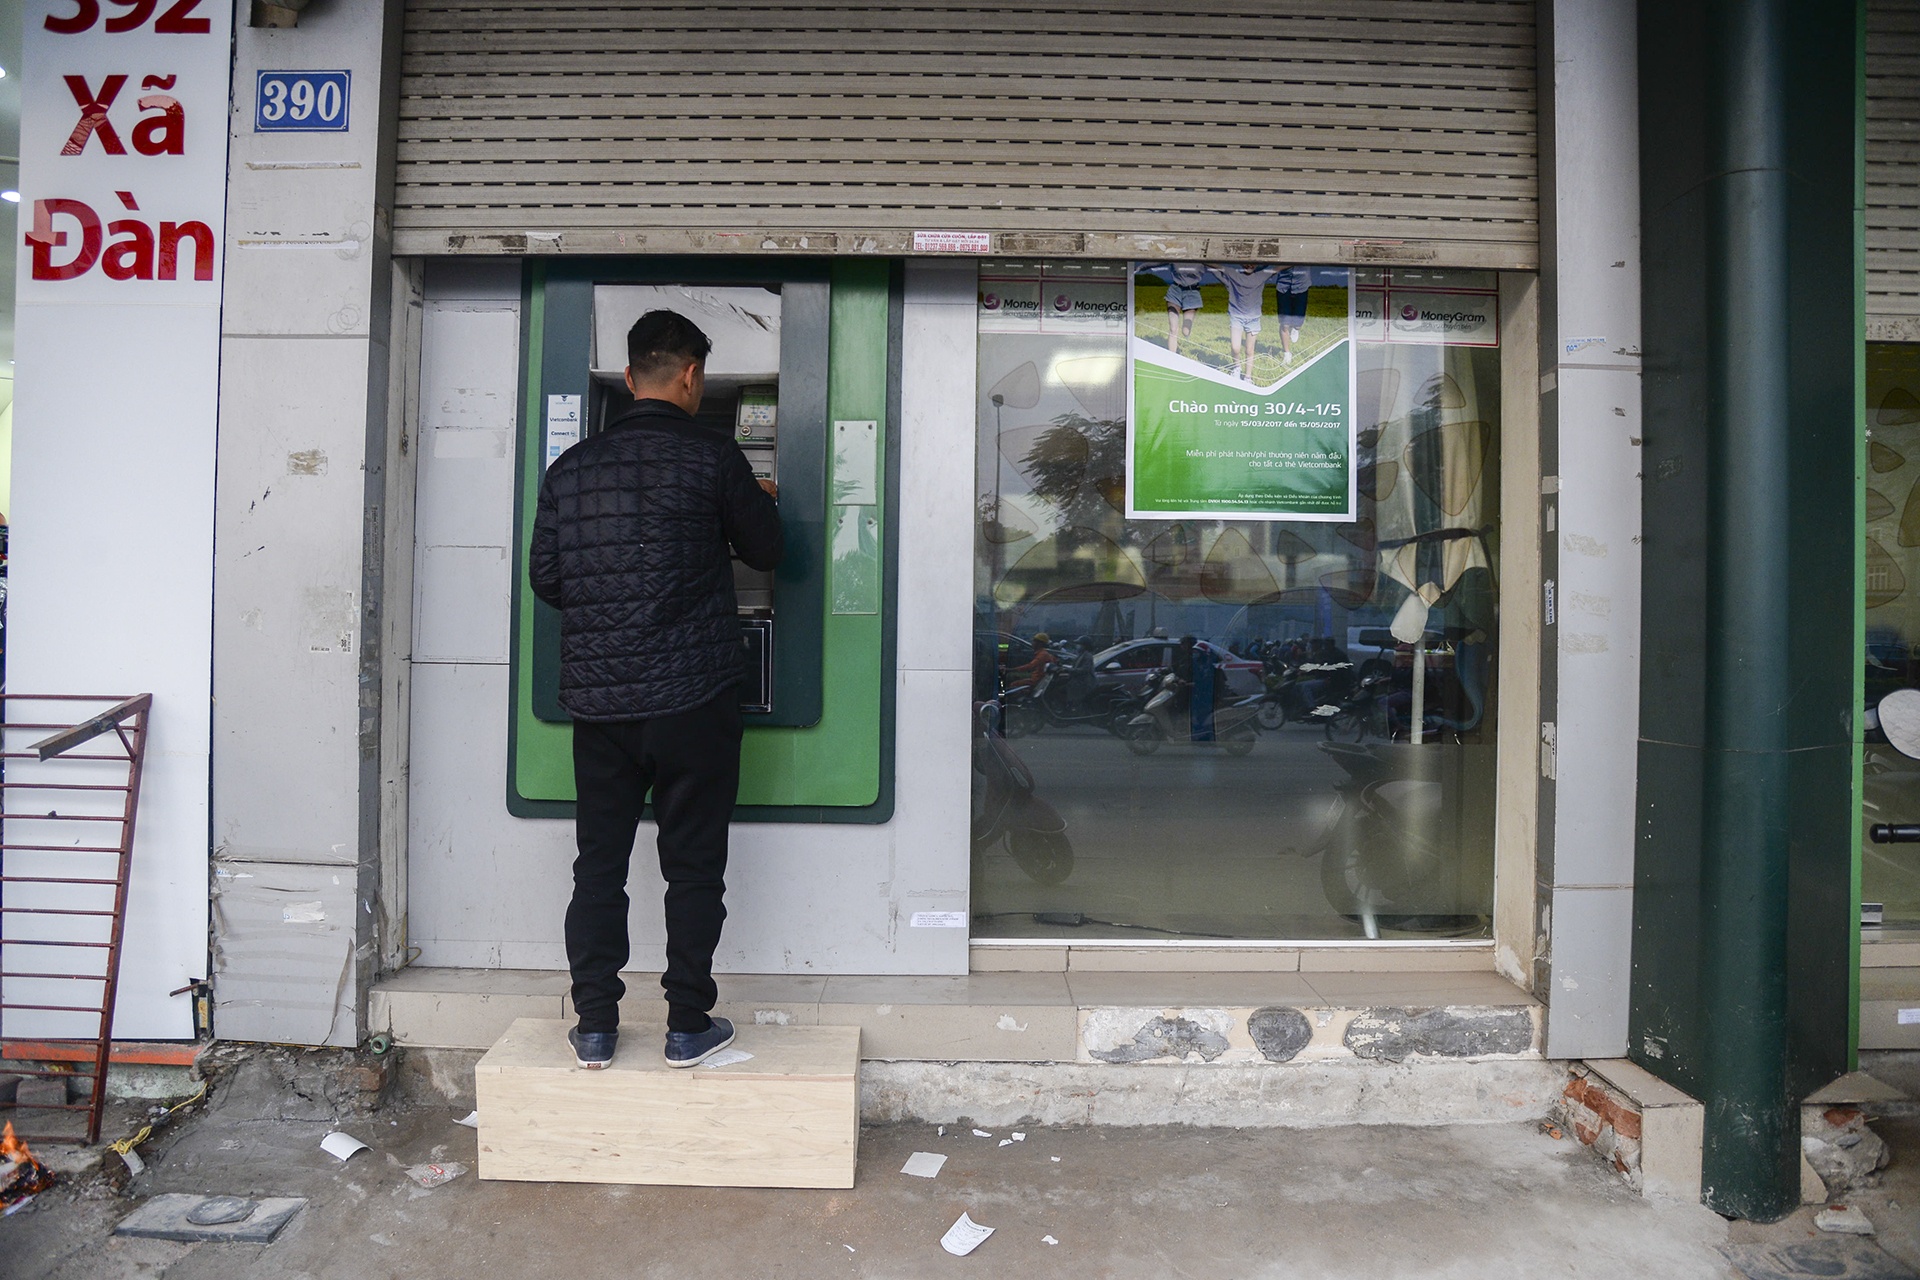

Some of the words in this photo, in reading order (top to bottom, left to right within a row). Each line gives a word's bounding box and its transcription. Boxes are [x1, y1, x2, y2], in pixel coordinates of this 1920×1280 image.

[262, 80, 341, 121] 390
[60, 74, 185, 156] Xã
[25, 191, 214, 280] Đàn
[1003, 299, 1039, 310] Money
[1421, 310, 1485, 323] MoneyGram
[1169, 400, 1208, 414] Chào
[1214, 401, 1258, 416] mừng
[1223, 420, 1239, 428] ngày
[1240, 420, 1282, 428] 15/03/2017
[1284, 420, 1297, 428] đến
[1206, 450, 1216, 458] phí
[1219, 450, 1233, 458] phát
